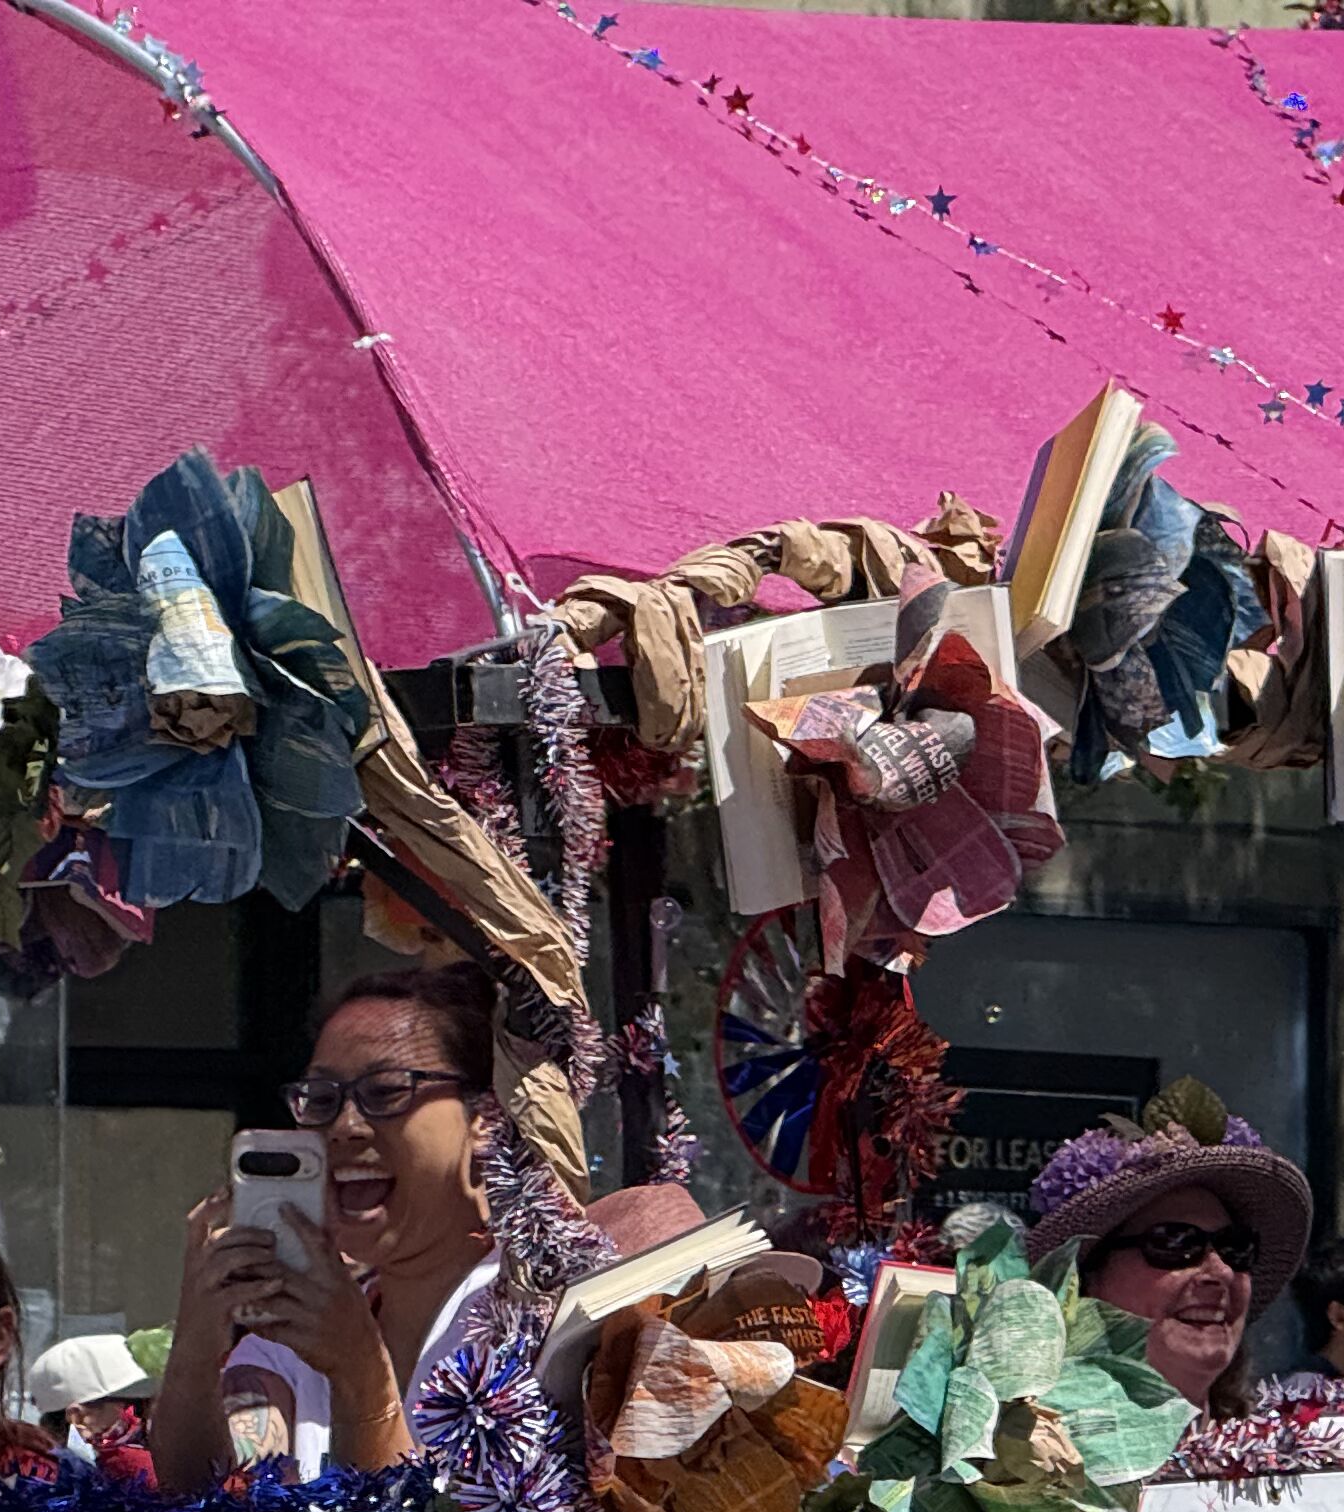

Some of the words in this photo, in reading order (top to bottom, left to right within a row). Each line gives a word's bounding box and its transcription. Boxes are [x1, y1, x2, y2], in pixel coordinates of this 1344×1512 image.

[934, 1135, 989, 1170] FOR
[995, 1137, 1064, 1171] LEAS
[736, 1307, 769, 1330] THE
